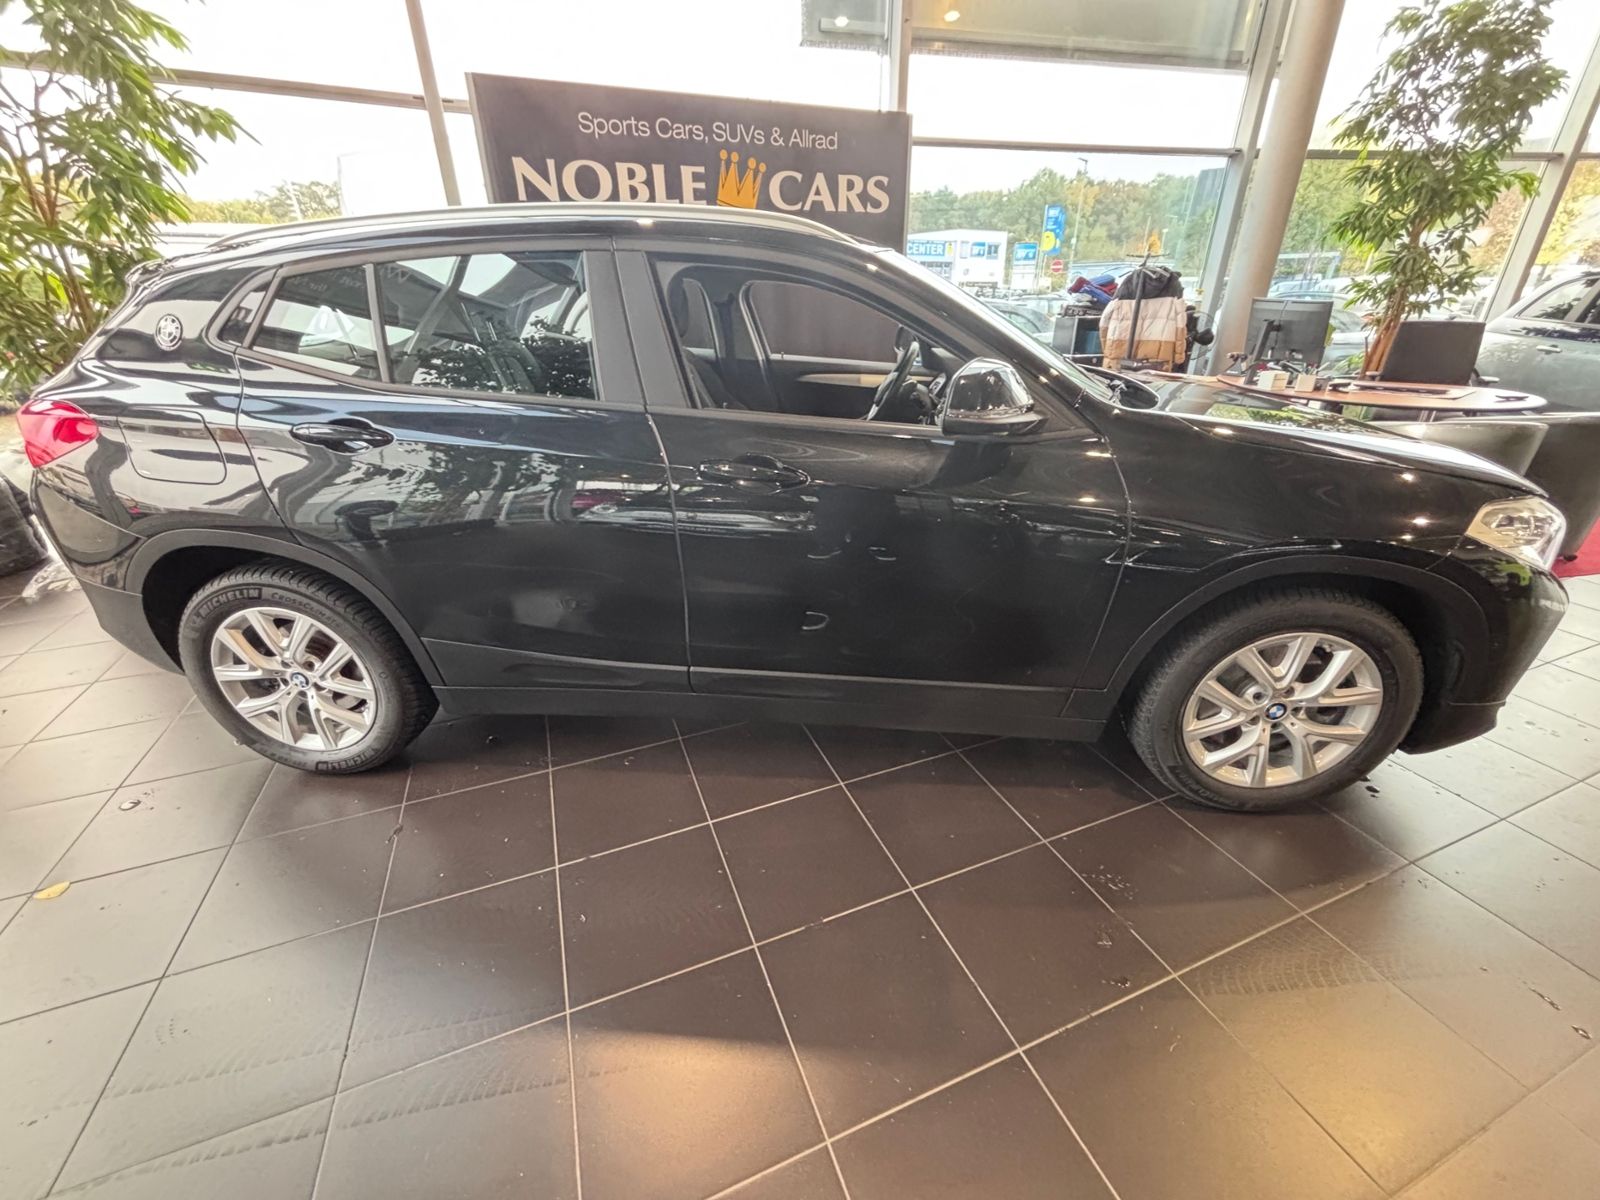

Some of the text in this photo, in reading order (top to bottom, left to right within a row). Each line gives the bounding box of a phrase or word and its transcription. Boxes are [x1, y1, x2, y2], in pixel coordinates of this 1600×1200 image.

[577, 111, 839, 151] Sports Cars, SUVs & Allrad
[511, 156, 890, 214] NOBLE CARS
[906, 243, 944, 256] CENTER
[200, 588, 260, 617] MICHELIN
